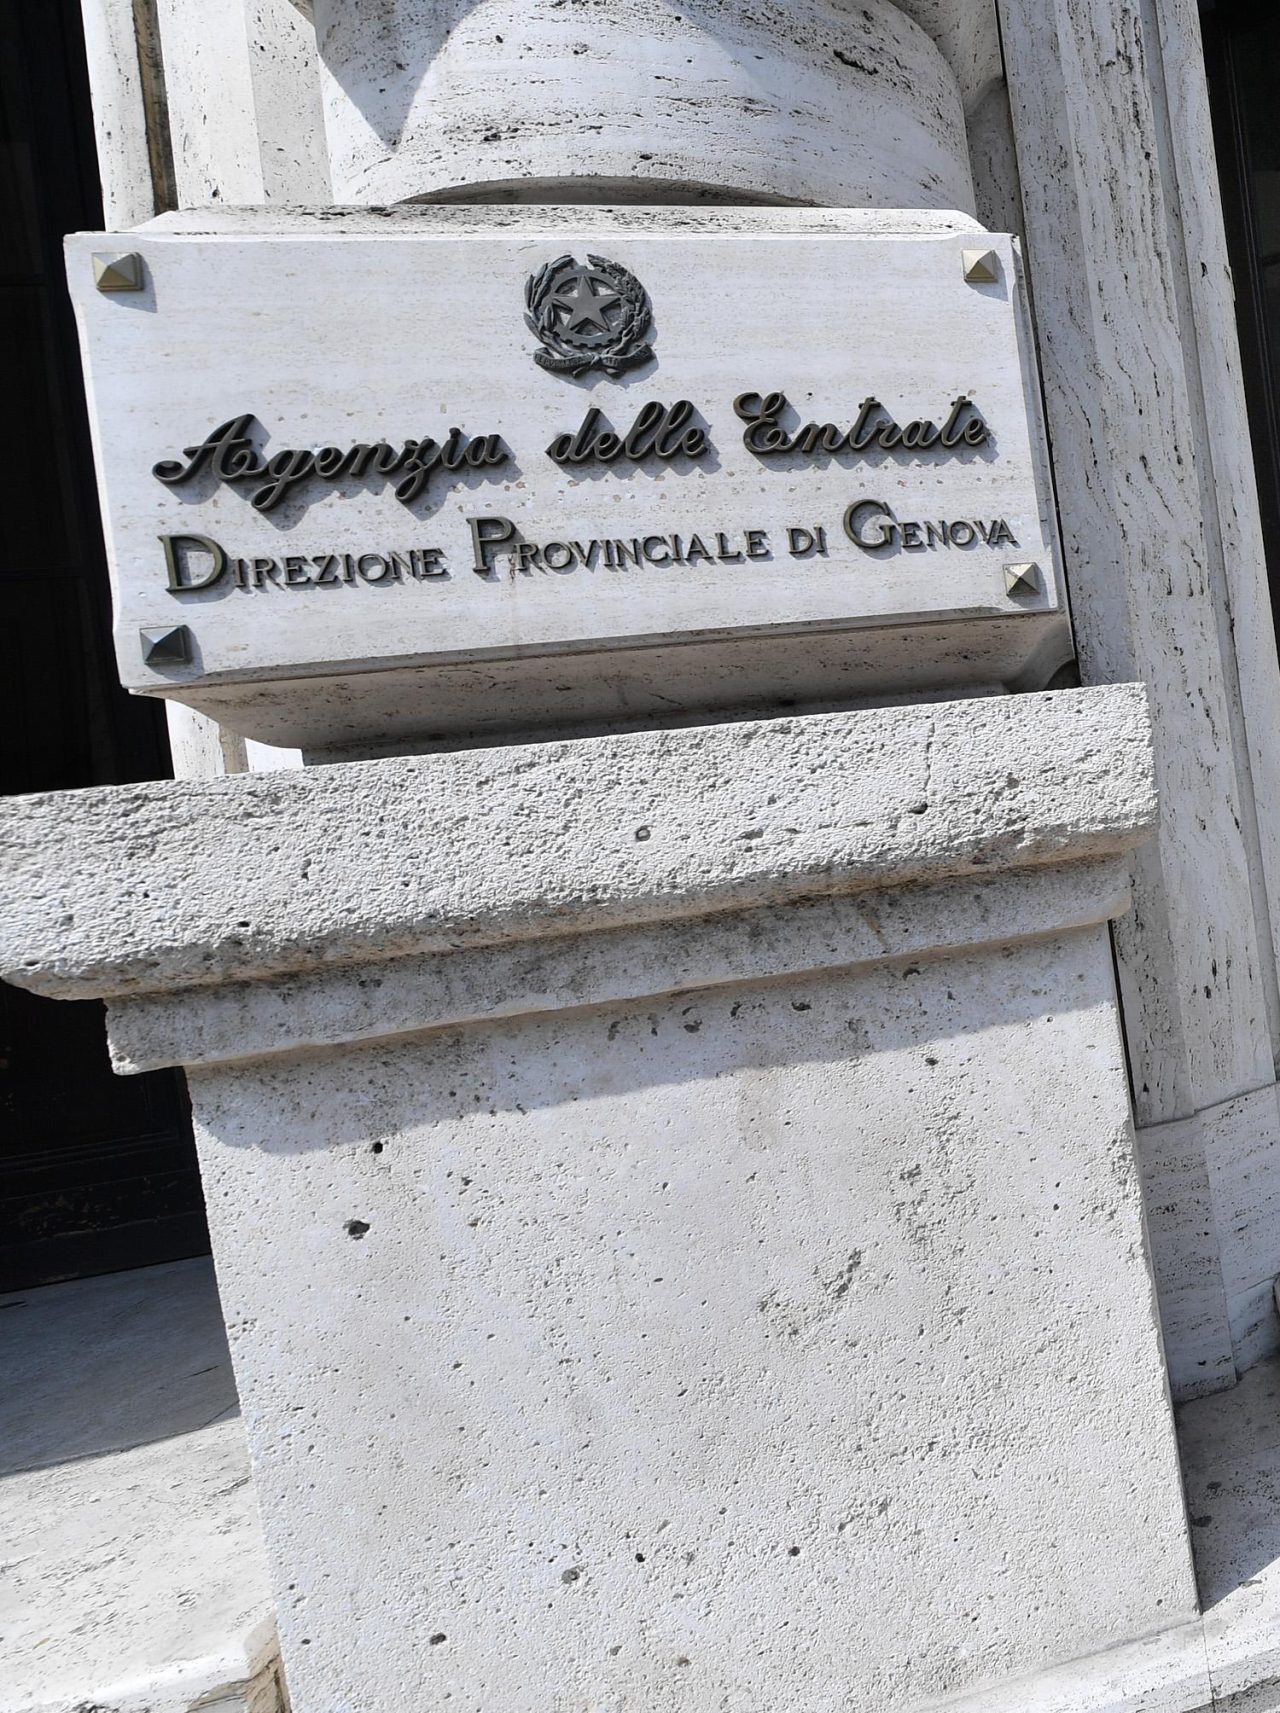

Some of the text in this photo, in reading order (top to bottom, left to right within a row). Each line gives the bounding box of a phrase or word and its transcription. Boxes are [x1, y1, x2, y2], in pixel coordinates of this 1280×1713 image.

[152, 392, 990, 511] Agenzia delle Entrate
[158, 499, 1019, 593] DIREZIONE PROVINCIALE DI GENOVA
